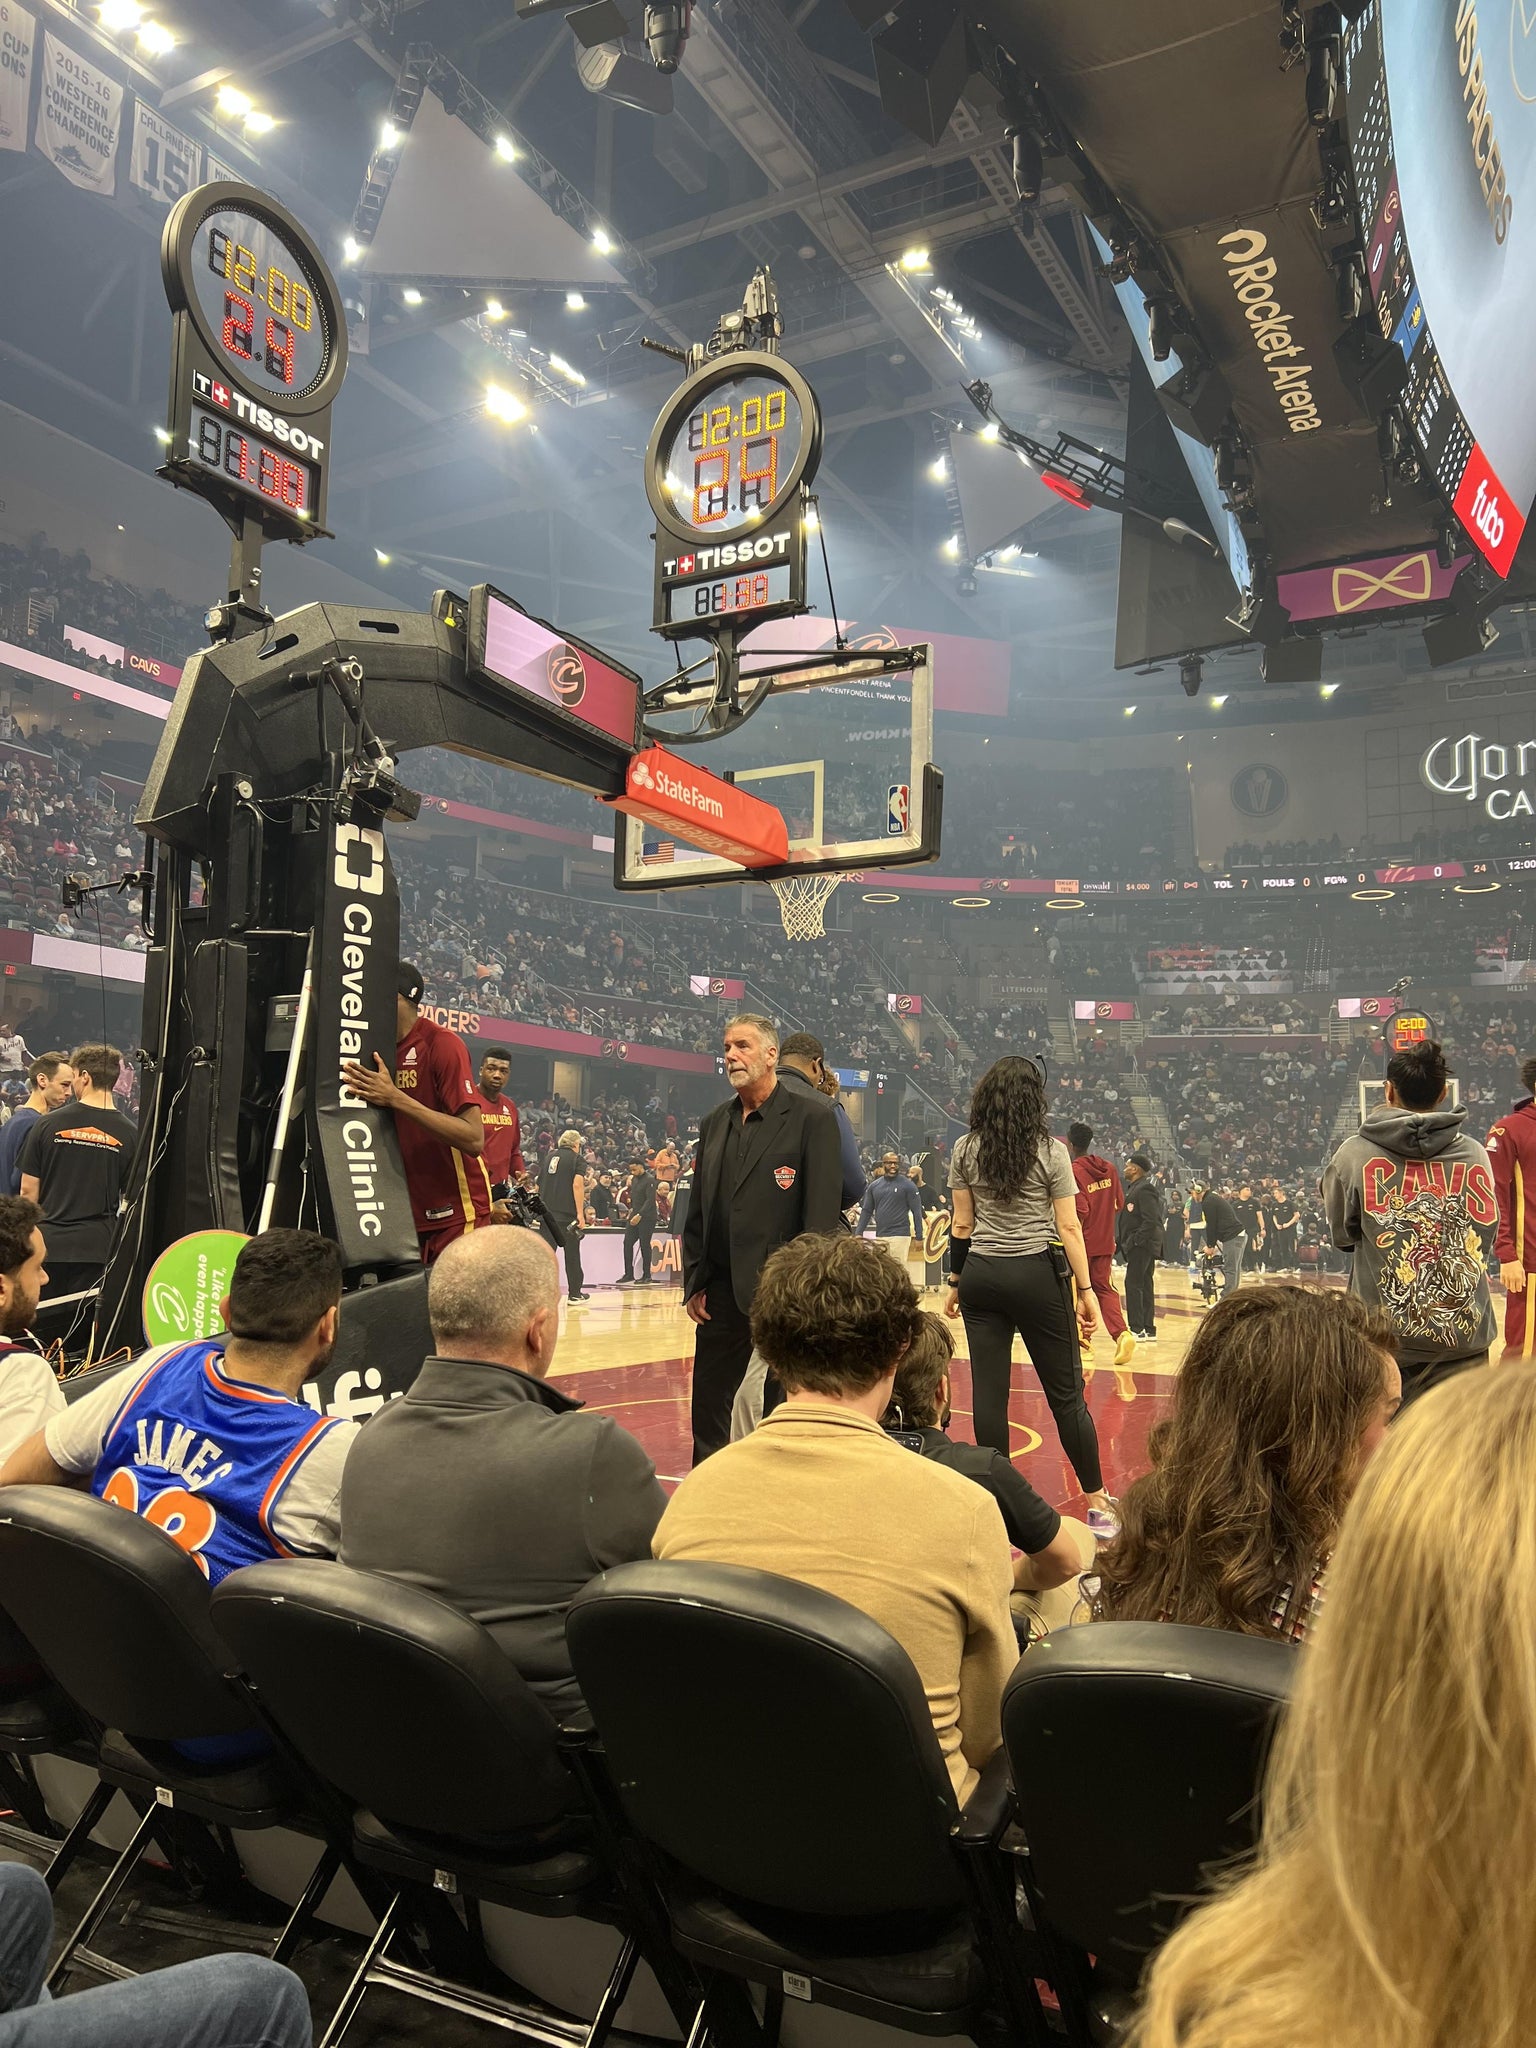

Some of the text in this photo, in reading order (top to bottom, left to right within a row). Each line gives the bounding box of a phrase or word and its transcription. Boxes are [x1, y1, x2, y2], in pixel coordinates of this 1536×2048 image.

[3, 31, 30, 59] CUP
[56, 51, 111, 102] 2015-16
[56, 72, 109, 122] WESTERN
[45, 85, 115, 144] CONFERENCE
[46, 104, 111, 159] CHAMPIONS
[140, 112, 197, 162] CALLANDER
[143, 136, 191, 203] 15
[1464, 48, 1513, 245] PACERS
[222, 236, 313, 333] 12:00
[221, 289, 296, 385] 24
[1228, 256, 1322, 433] Rocket Arena
[233, 392, 324, 461] TISSOT
[700, 389, 787, 449] 12:00
[692, 435, 778, 525] 24
[1470, 478, 1504, 549] fubo
[696, 532, 791, 571] TISSOT
[128, 653, 162, 678] CAVS
[876, 692, 896, 701] THANK
[1083, 881, 1111, 891] oswald
[1213, 880, 1234, 890] TOL
[1241, 879, 1249, 889] 7
[1262, 878, 1295, 888] FOULS
[1303, 877, 1311, 887] 0
[1324, 875, 1348, 885] FG%
[1358, 873, 1366, 883] 0
[1433, 866, 1443, 878] 0
[1473, 864, 1488, 873] 24
[416, 1003, 481, 1034] PACERS
[1396, 1017, 1428, 1030] 12:00
[70, 1130, 110, 1143] SERVPRO
[481, 1113, 513, 1126] CAVALIERS
[341, 1118, 385, 1238] Clinic
[1361, 1156, 1498, 1228] CAVS
[197, 1253, 208, 1289] even
[133, 1417, 233, 1492] JAMES
